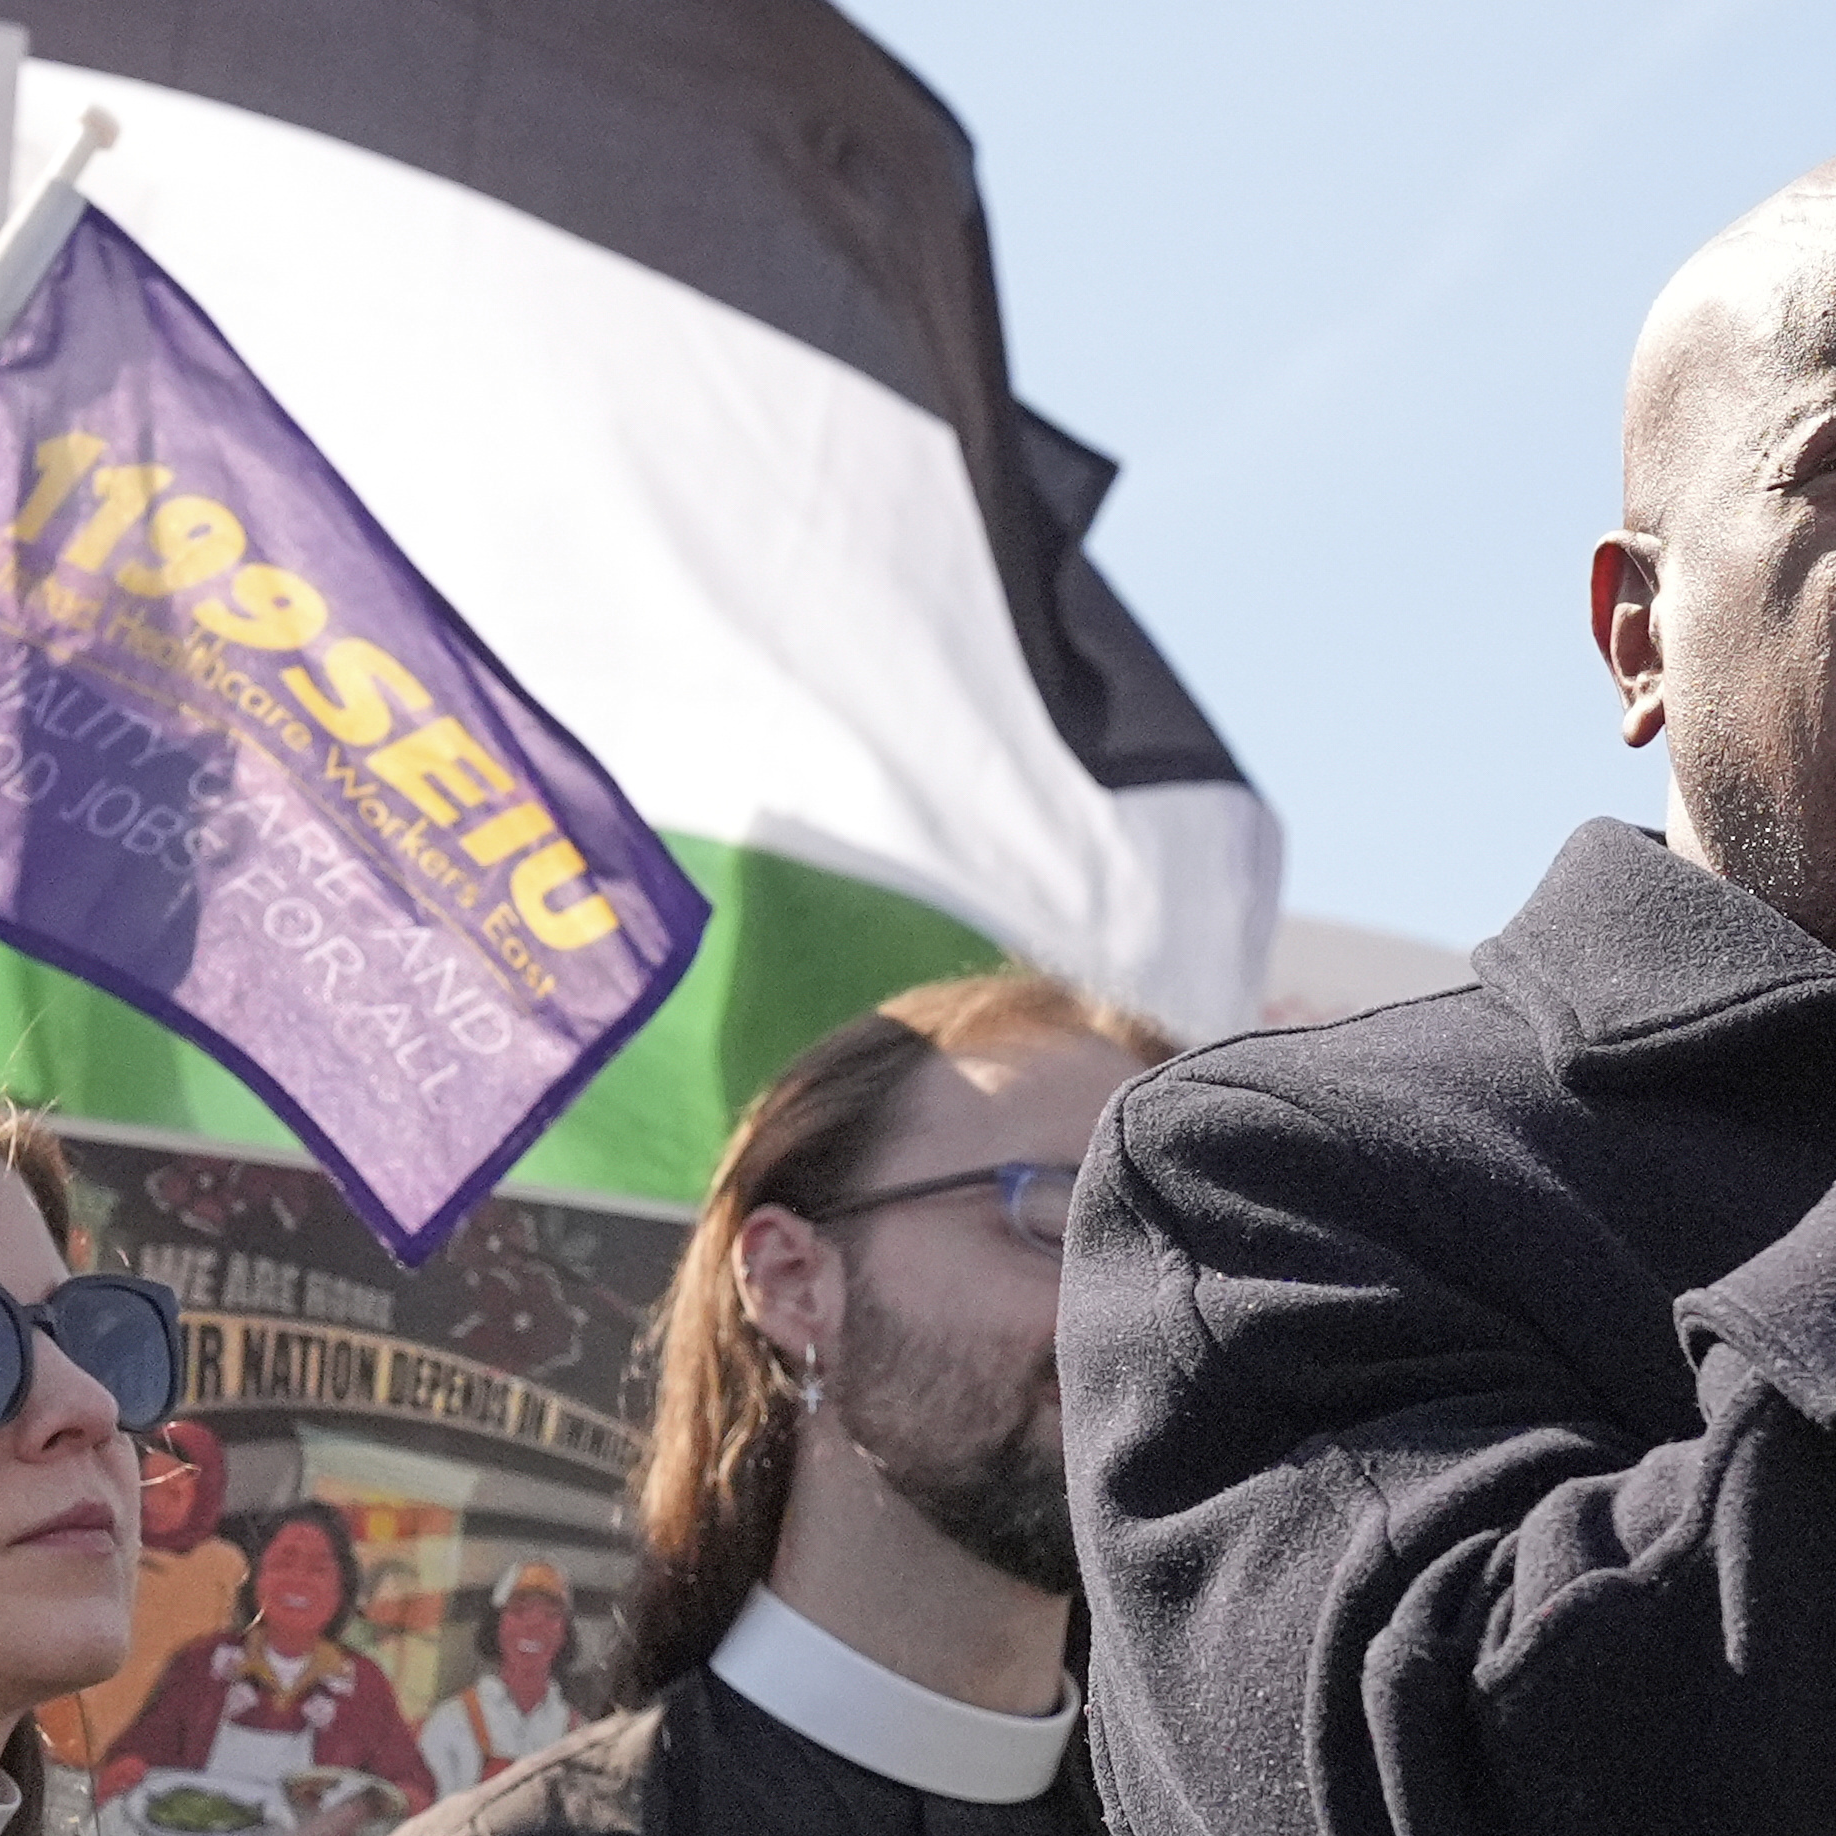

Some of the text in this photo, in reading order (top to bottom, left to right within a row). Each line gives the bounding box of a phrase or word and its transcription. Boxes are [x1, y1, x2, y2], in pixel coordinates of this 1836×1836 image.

[7, 430, 620, 953] 1199SEIU
[62, 777, 229, 874] JOBS
[211, 863, 367, 1003] FOR
[361, 1002, 461, 1114] ALL
[187, 757, 369, 906] CARE
[369, 924, 513, 1055] AND
[323, 744, 479, 909] Workers
[481, 901, 557, 1000] East
[241, 1326, 380, 1399] NATION
